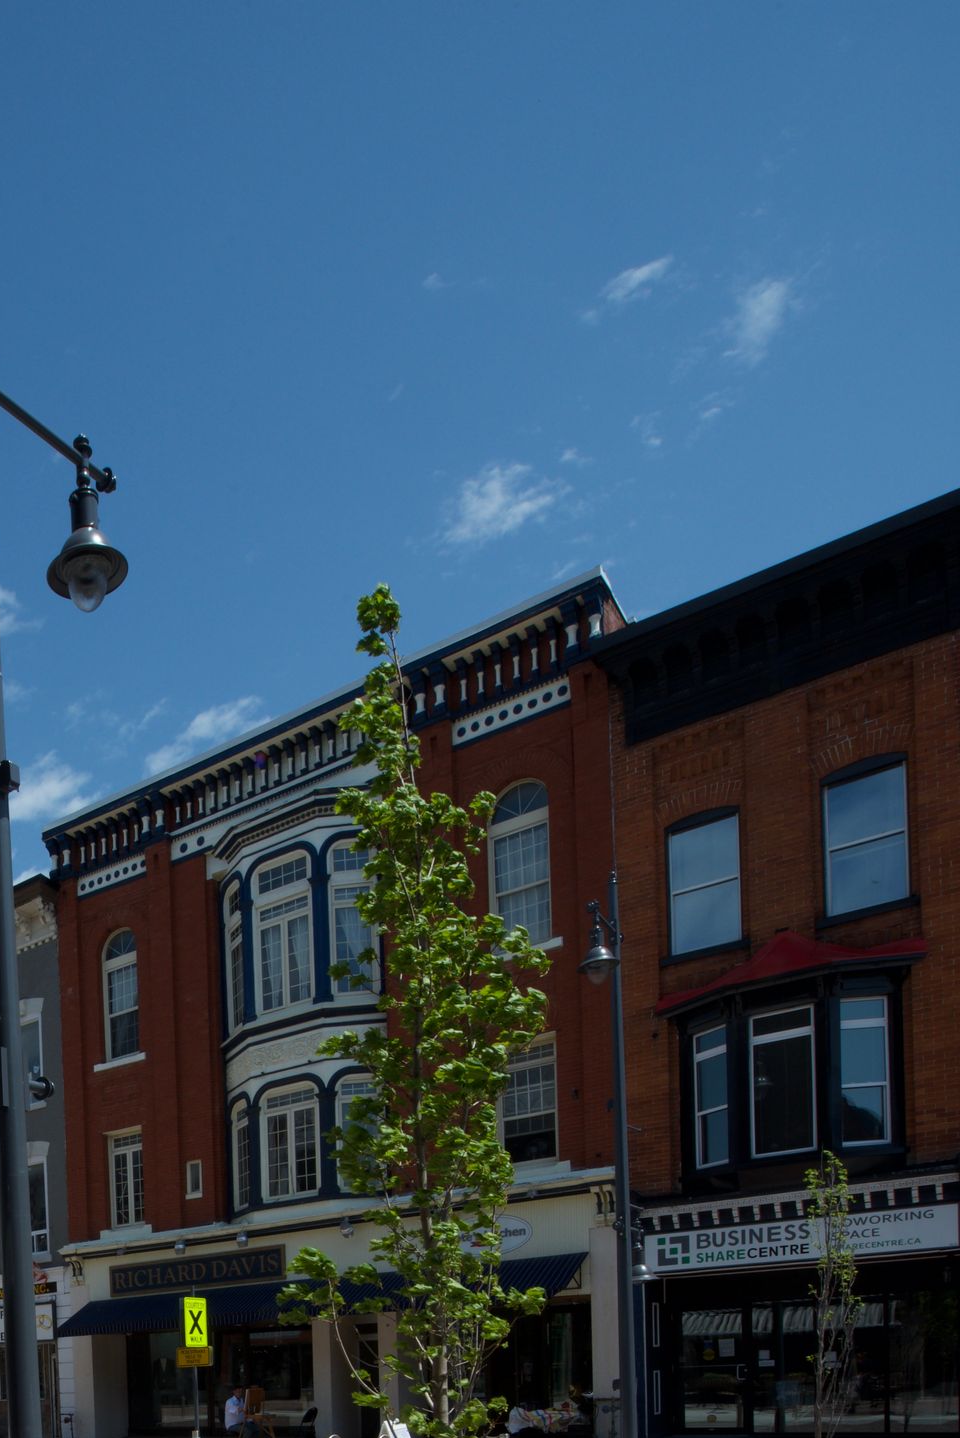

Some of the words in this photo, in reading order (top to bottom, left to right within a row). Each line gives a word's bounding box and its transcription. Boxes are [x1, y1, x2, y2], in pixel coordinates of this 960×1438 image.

[834, 1209, 935, 1227] OWORKING
[696, 1223, 811, 1249] BUSINESS
[696, 1243, 810, 1263] SHARECENTRE
[114, 1263, 206, 1289] RICHARD
[211, 1253, 279, 1279] DAVIS
[189, 1310, 203, 1334] X
